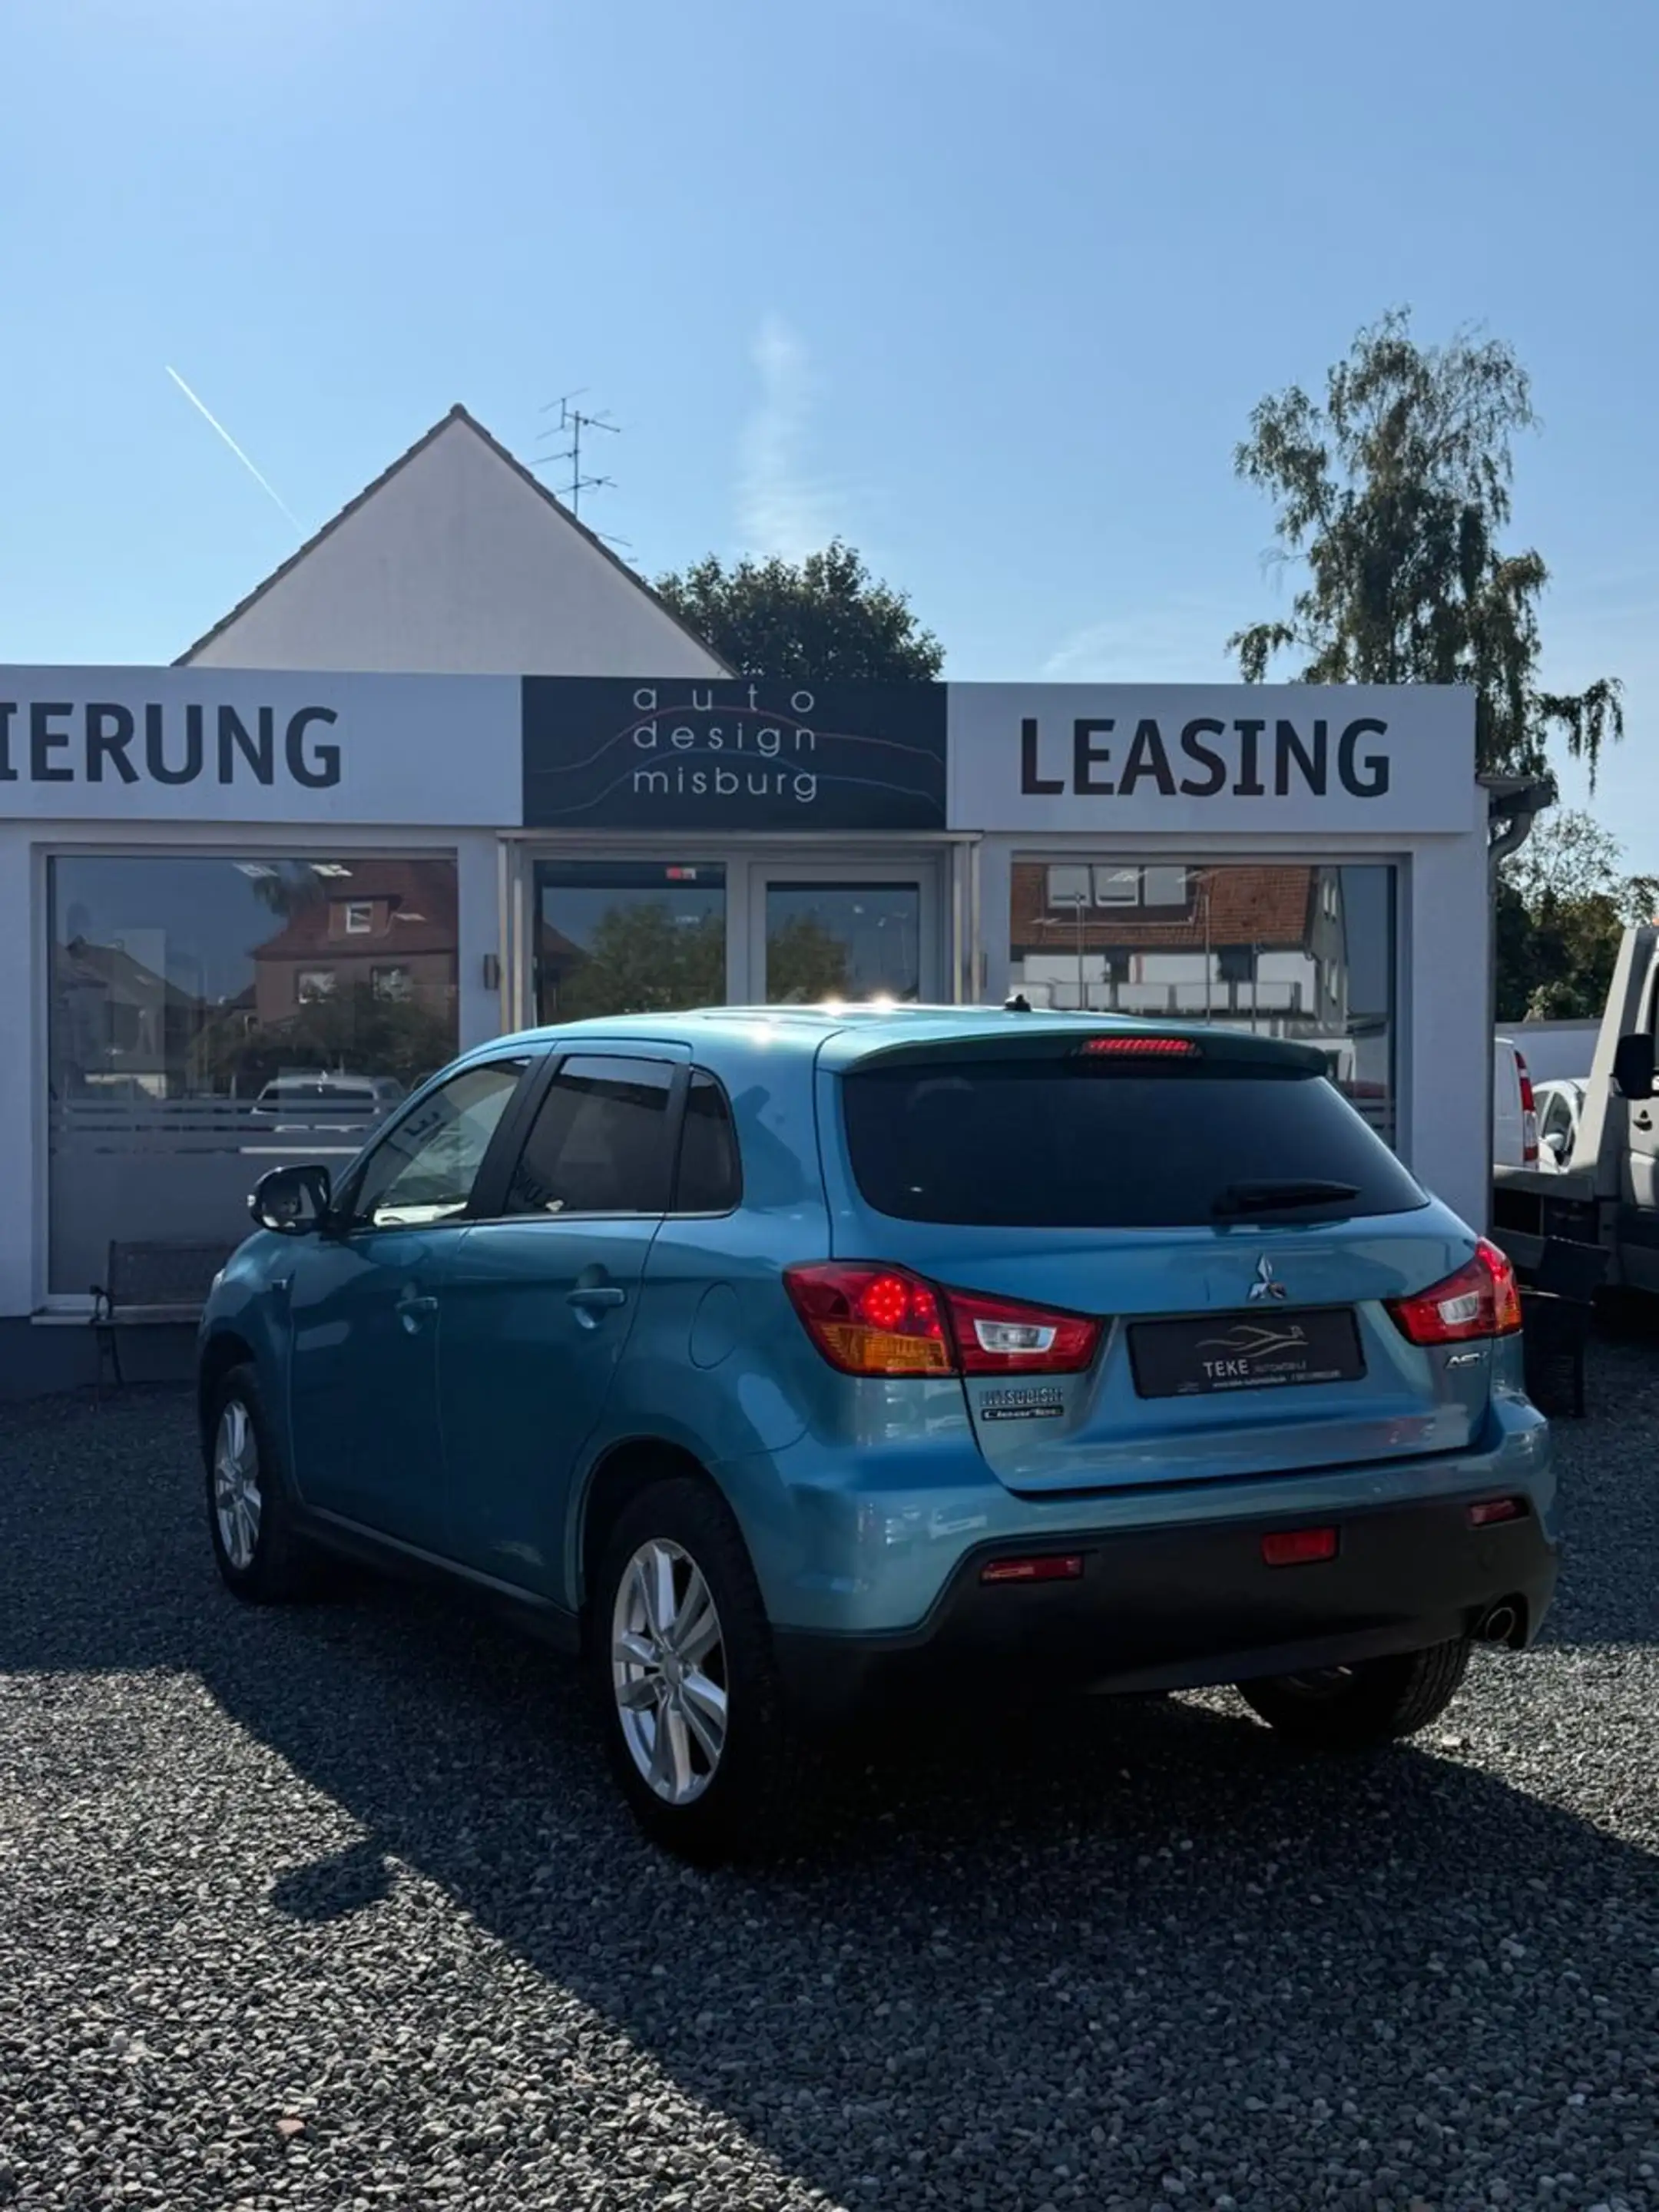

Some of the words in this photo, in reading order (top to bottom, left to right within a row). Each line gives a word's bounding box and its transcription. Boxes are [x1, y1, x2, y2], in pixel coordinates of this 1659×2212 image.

[633, 683, 814, 713] auto
[633, 720, 815, 757] design
[1021, 717, 1390, 797] LEASING
[634, 767, 816, 802] misburg
[1202, 1359, 1249, 1378] TEKE
